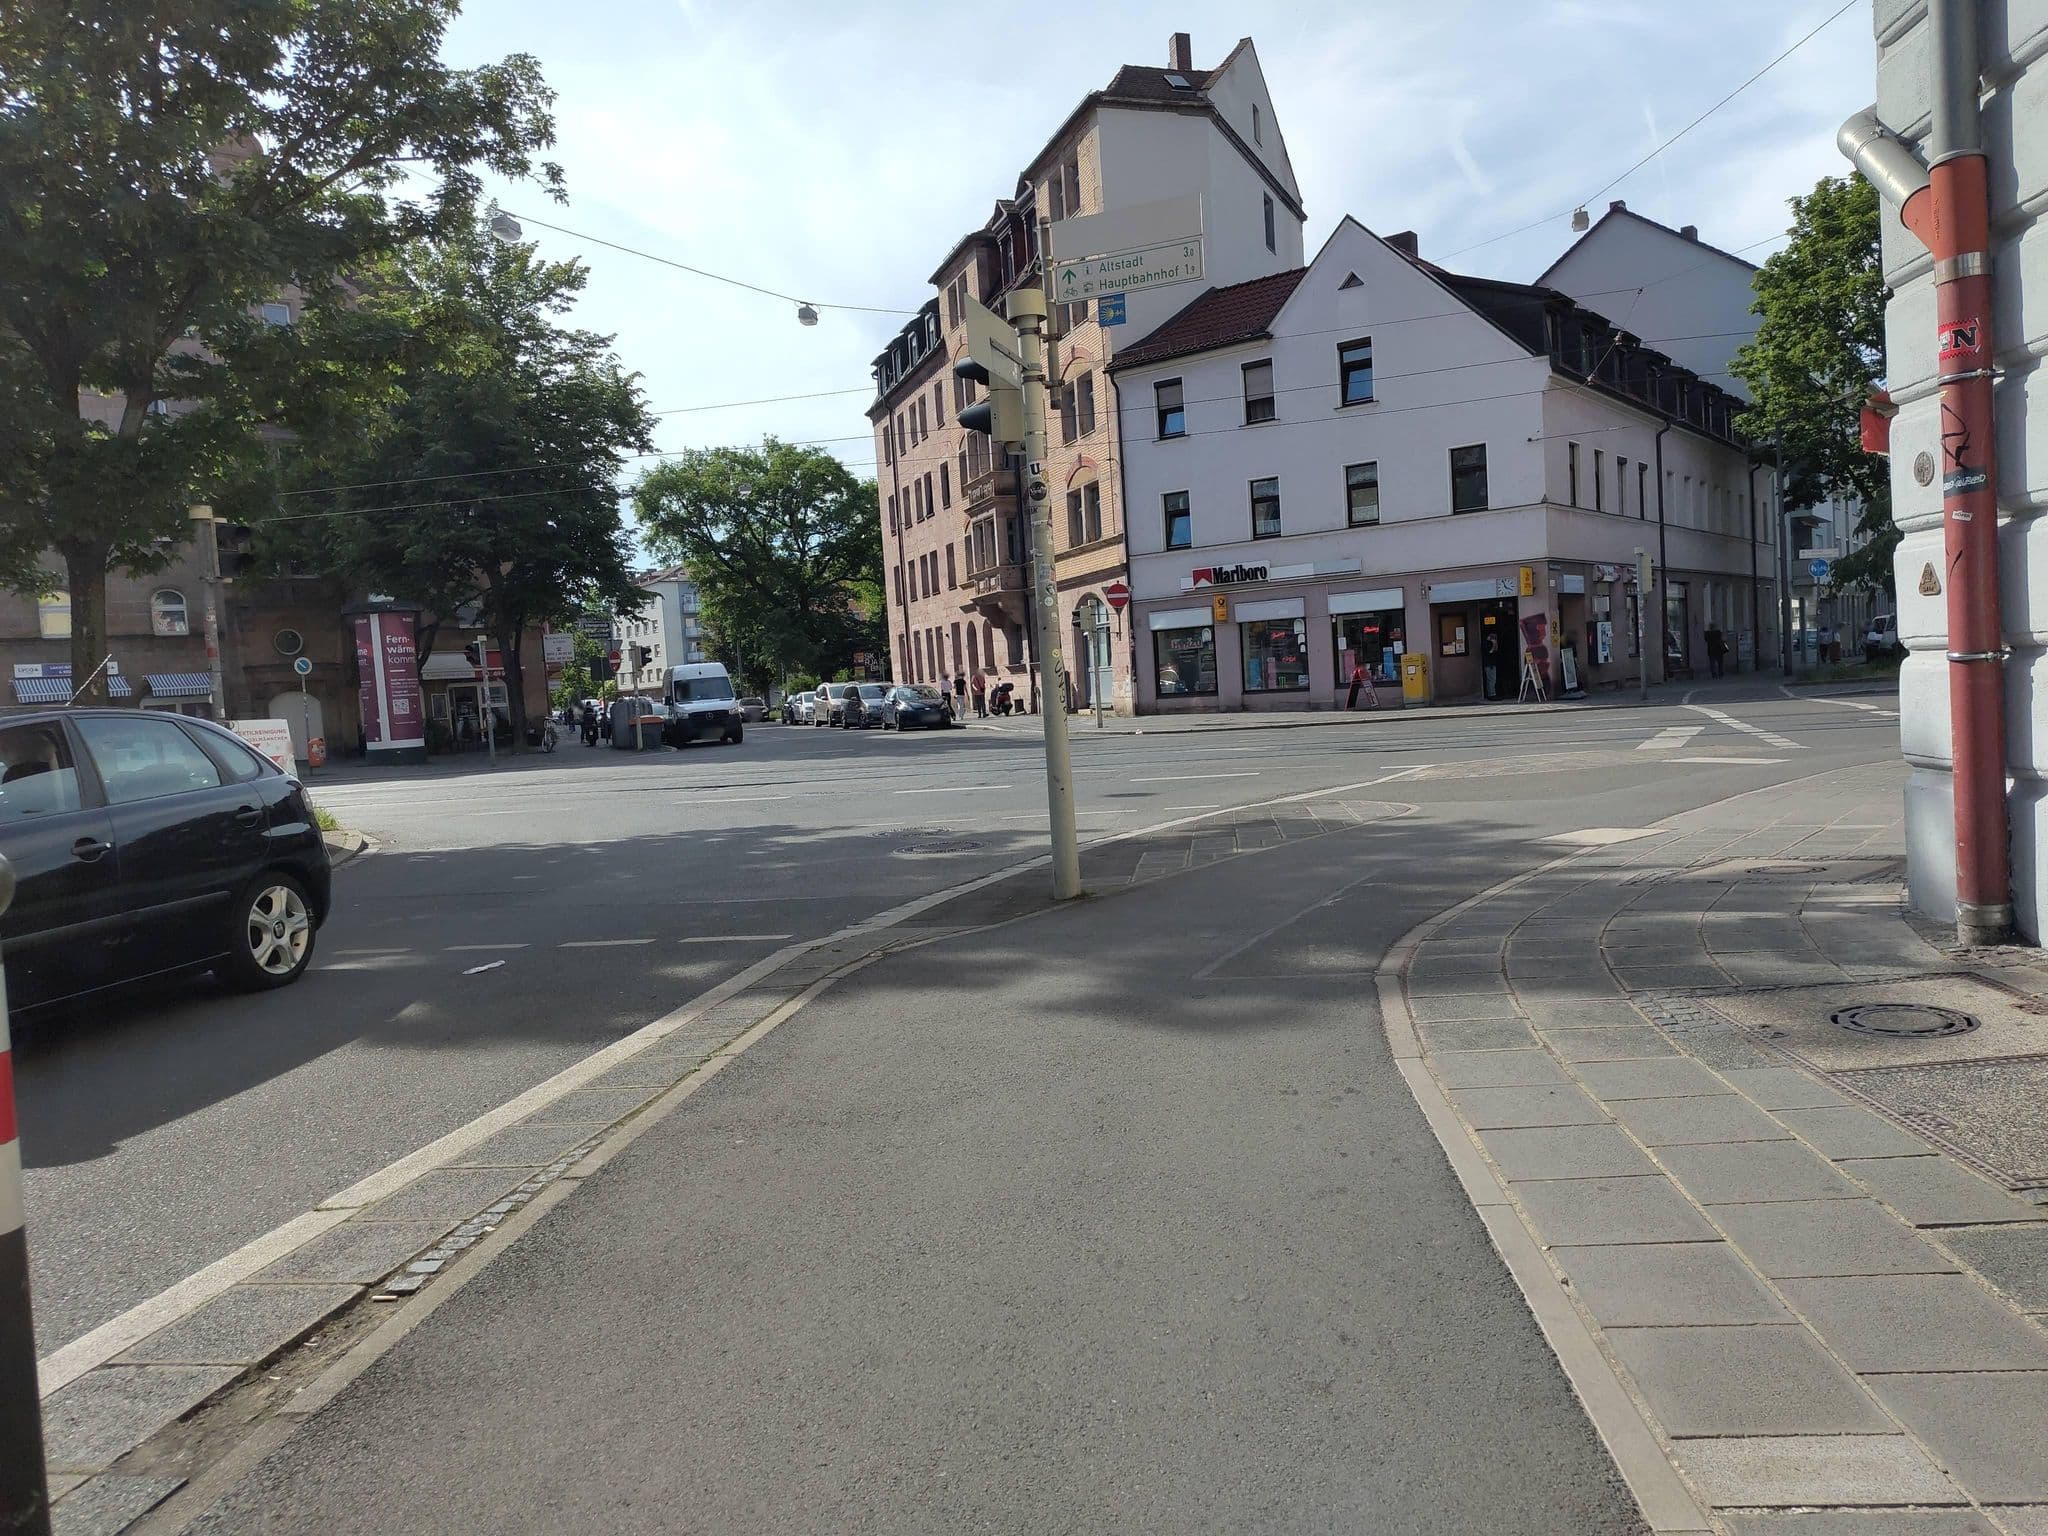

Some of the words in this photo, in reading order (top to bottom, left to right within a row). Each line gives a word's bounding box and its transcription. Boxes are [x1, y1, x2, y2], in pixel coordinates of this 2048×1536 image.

[1099, 256, 1144, 273] Altstadt
[1099, 265, 1180, 291] Hauptbahnhof
[1211, 564, 1268, 585] Marlboro
[386, 634, 410, 644] Fern-
